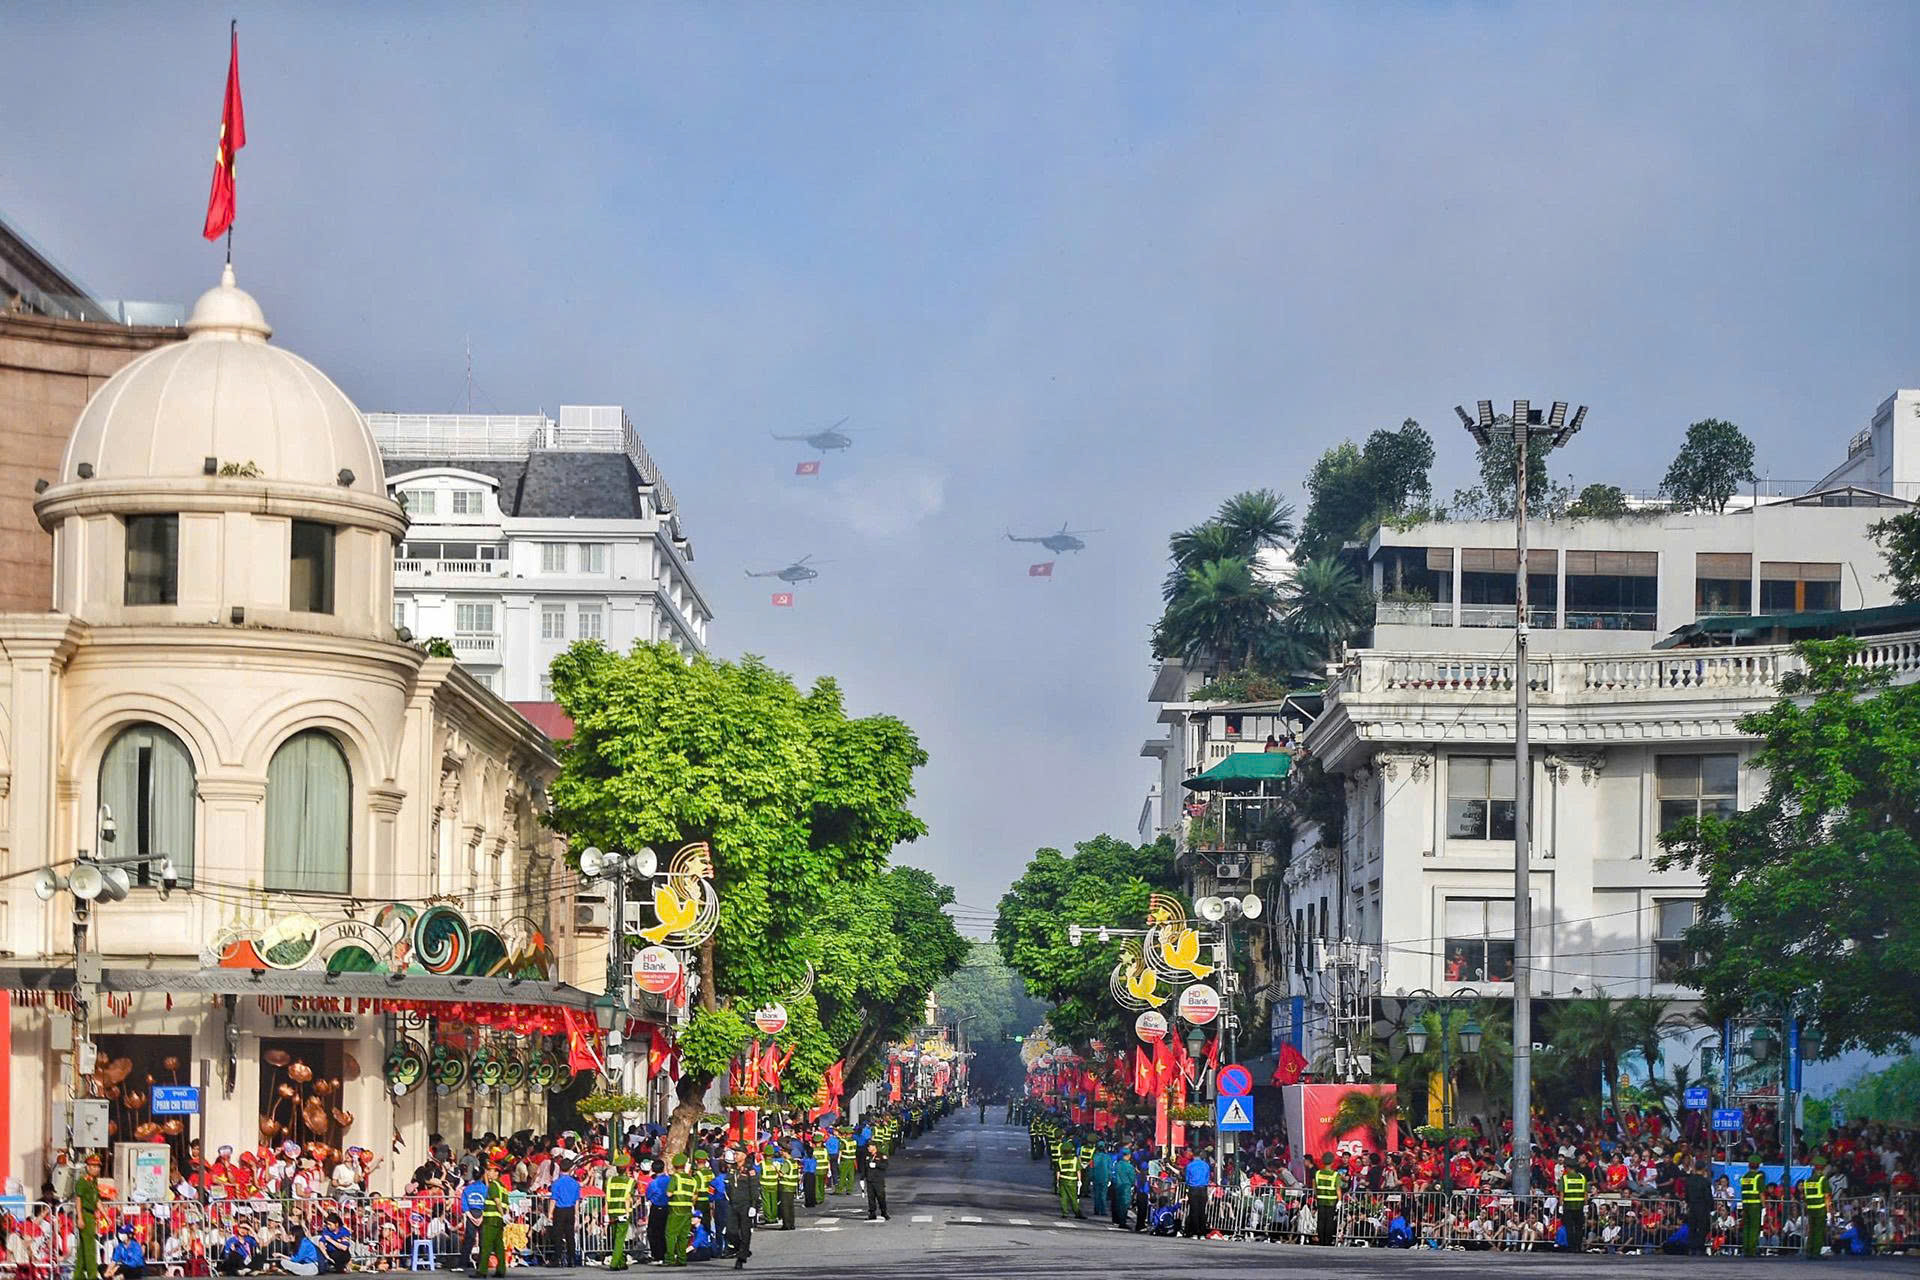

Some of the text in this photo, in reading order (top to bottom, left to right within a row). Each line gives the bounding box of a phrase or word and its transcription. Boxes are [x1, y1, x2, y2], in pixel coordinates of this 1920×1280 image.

[338, 925, 364, 938] HNX
[643, 953, 657, 962] HD
[643, 962, 666, 971] Bank
[1188, 997, 1209, 1005] Bank
[274, 1014, 355, 1030] EXCHANGE
[1336, 1140, 1363, 1158] 5G
